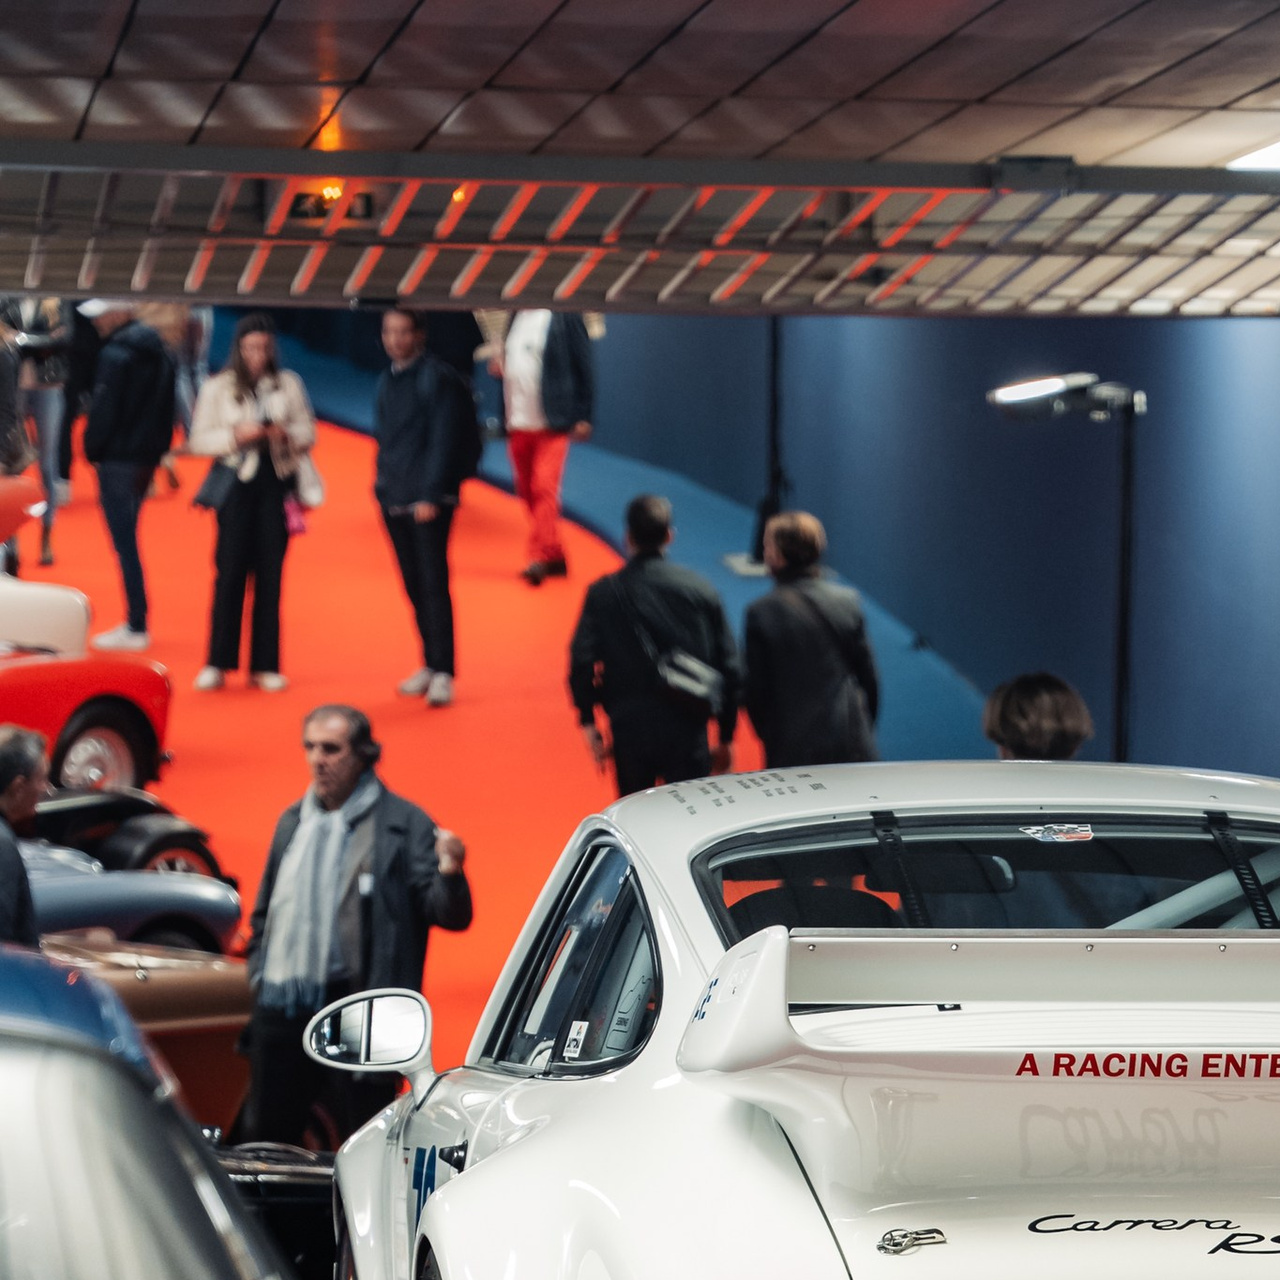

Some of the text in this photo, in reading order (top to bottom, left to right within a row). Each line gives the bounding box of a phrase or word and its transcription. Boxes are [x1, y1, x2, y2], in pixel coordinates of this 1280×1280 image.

[1015, 1053, 1040, 1077] A
[1052, 1052, 1189, 1079] RACING
[1027, 1213, 1242, 1235] Carrera
